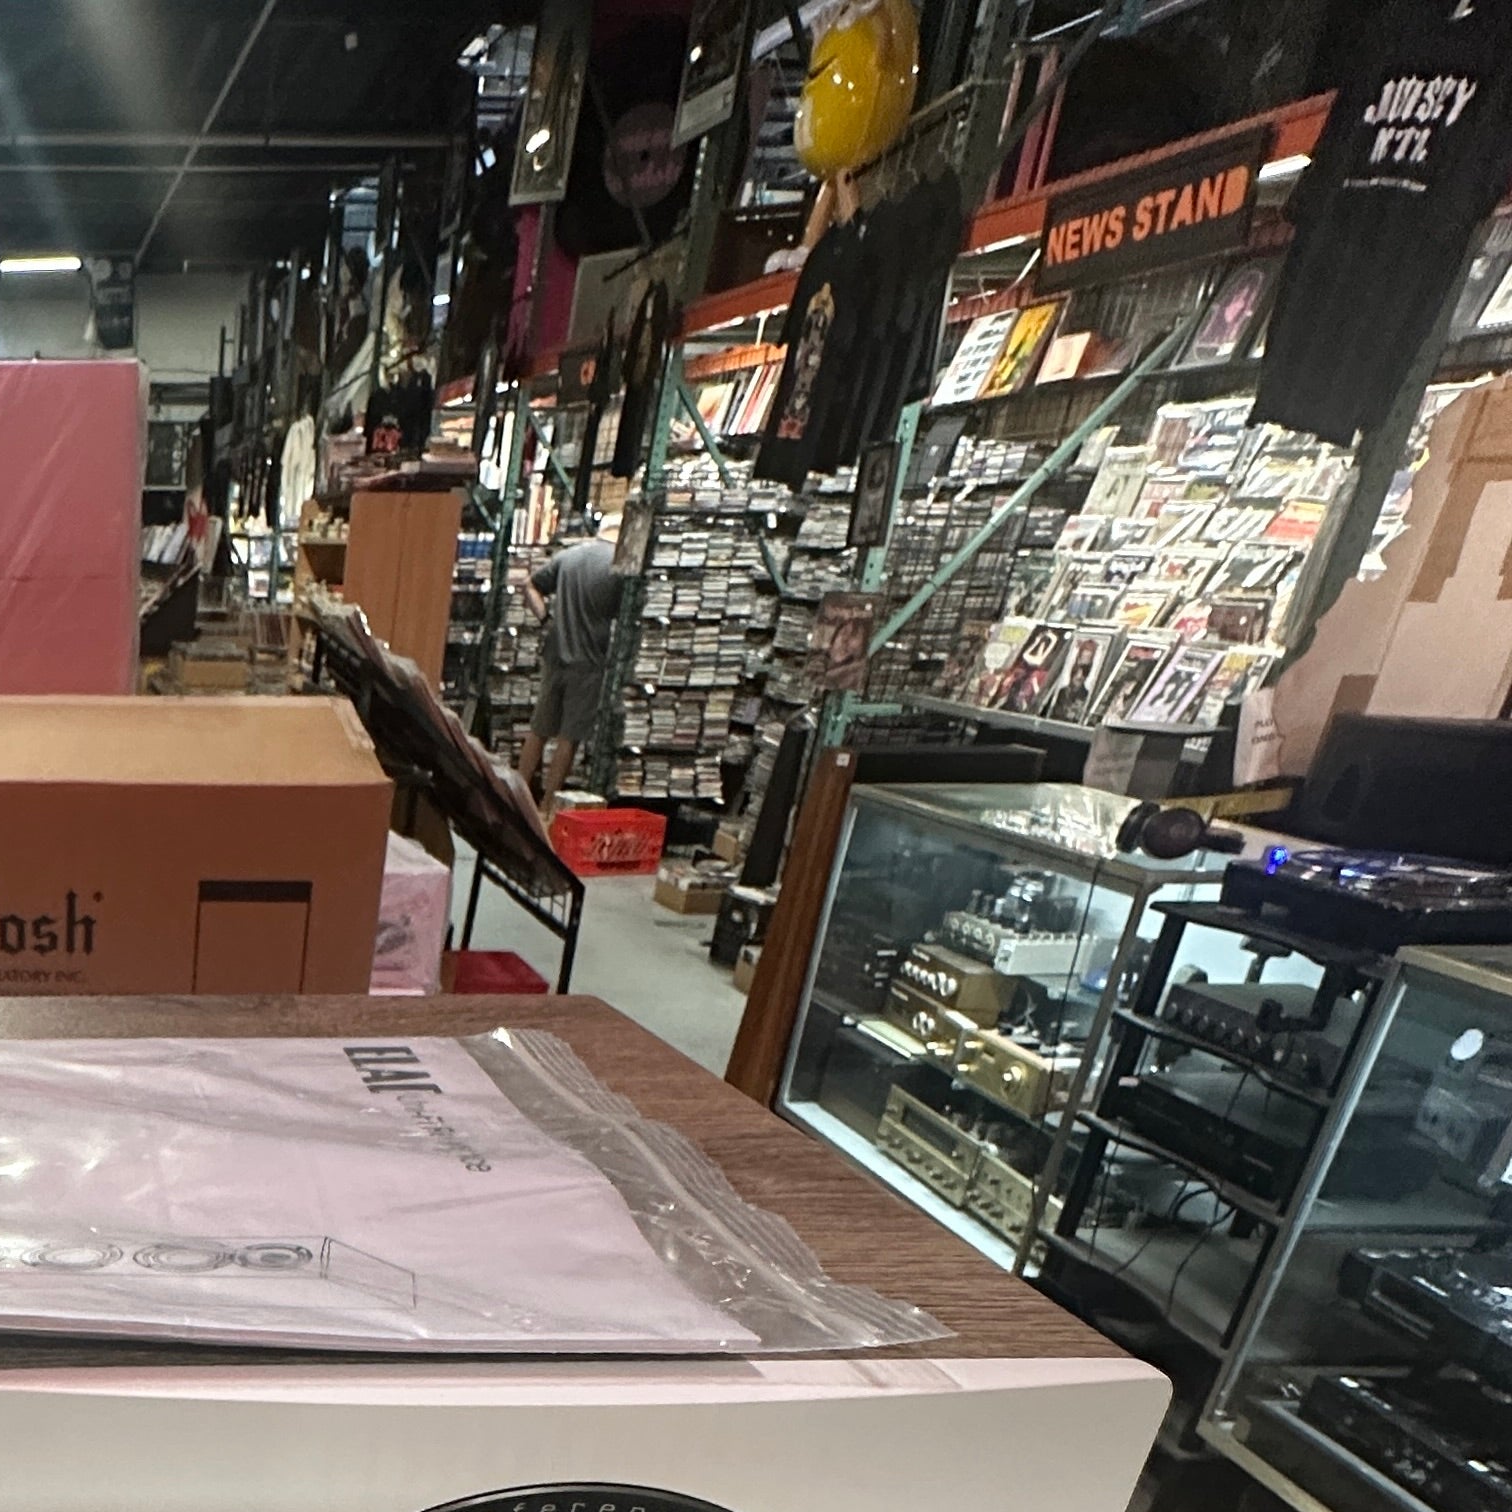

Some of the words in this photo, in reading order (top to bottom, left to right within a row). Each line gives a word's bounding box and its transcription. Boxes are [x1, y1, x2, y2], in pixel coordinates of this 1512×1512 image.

[1047, 205, 1126, 265] NEWS
[1132, 165, 1249, 241] STAND
[343, 1046, 443, 1095] ELAC
